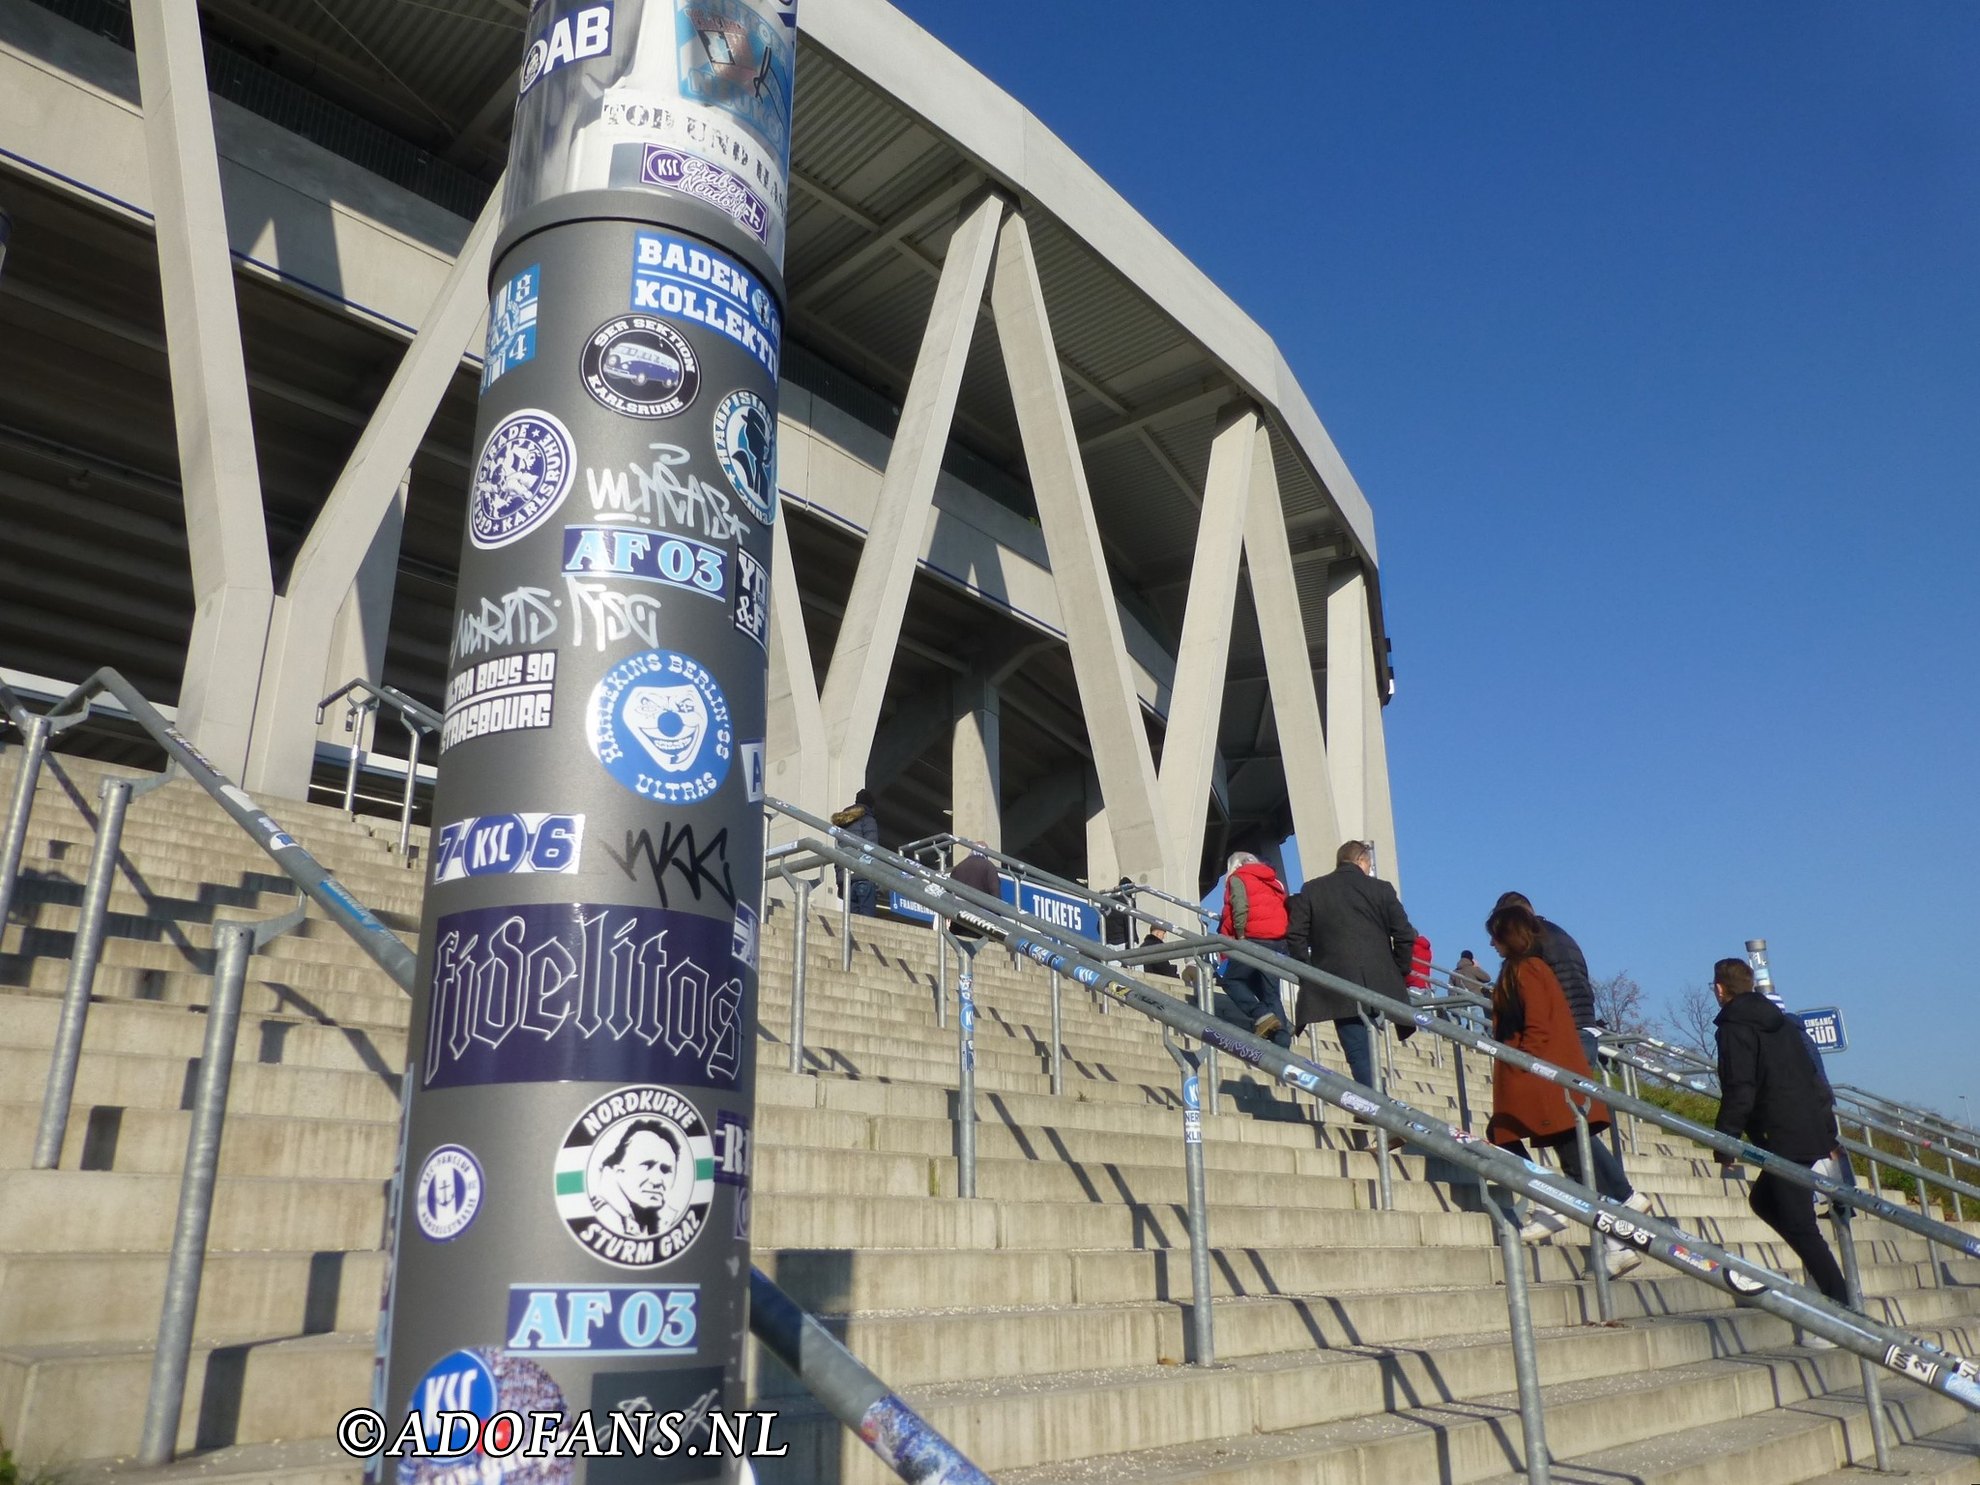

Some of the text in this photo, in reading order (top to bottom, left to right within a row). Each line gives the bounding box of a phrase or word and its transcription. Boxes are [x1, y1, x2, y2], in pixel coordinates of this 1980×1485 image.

[657, 158, 680, 177] KSC
[681, 157, 748, 203] Graben
[678, 175, 748, 220] Neudorf
[638, 237, 748, 304] BADEN
[633, 318, 696, 373] SEKTION
[587, 374, 684, 415] KARLSRUHE
[502, 433, 561, 533] KARLSRUHE
[566, 531, 724, 592] AF 03
[476, 655, 523, 692] BOYS
[526, 652, 555, 682] 90
[440, 693, 552, 756] STRASBOURG
[635, 772, 718, 801] ULTRAS
[473, 822, 515, 870] KSC
[528, 814, 577, 871] 6
[1033, 894, 1082, 931] TICKETS
[1079, 968, 1093, 982] KSC
[1806, 1026, 1837, 1044] SÜD
[583, 1090, 698, 1136] NORDKURVE
[580, 1208, 701, 1263] STURM GRAZ
[508, 1290, 697, 1348] AF 03
[424, 1368, 478, 1438] KSC
